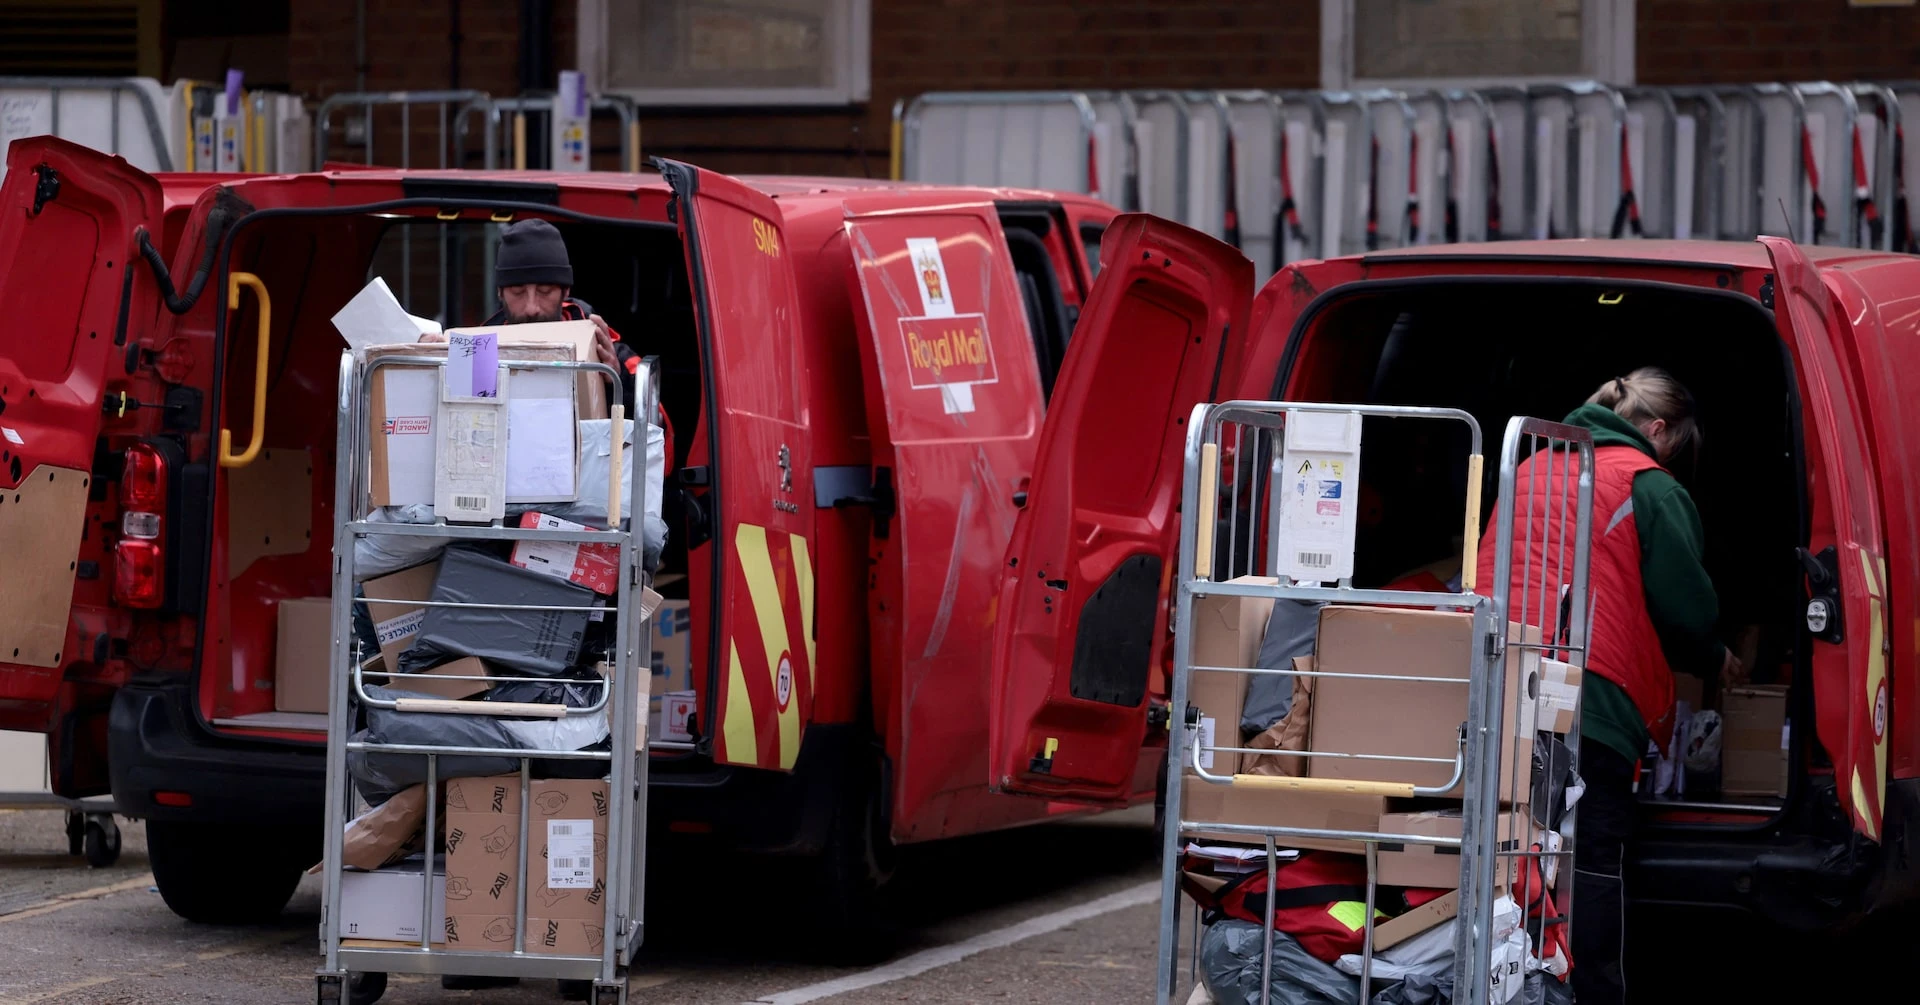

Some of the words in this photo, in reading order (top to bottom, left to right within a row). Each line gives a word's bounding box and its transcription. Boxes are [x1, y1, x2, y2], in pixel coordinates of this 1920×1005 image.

[753, 218, 779, 257] SM4
[908, 332, 953, 376] Royal
[952, 328, 987, 365] Mail
[780, 675, 789, 691] 70
[492, 786, 505, 813] ZATU
[592, 790, 607, 816] ZATU
[446, 828, 463, 855] ZATU
[489, 872, 508, 900] ZATU
[588, 878, 606, 905] ZATU
[545, 919, 558, 947] ZATU
